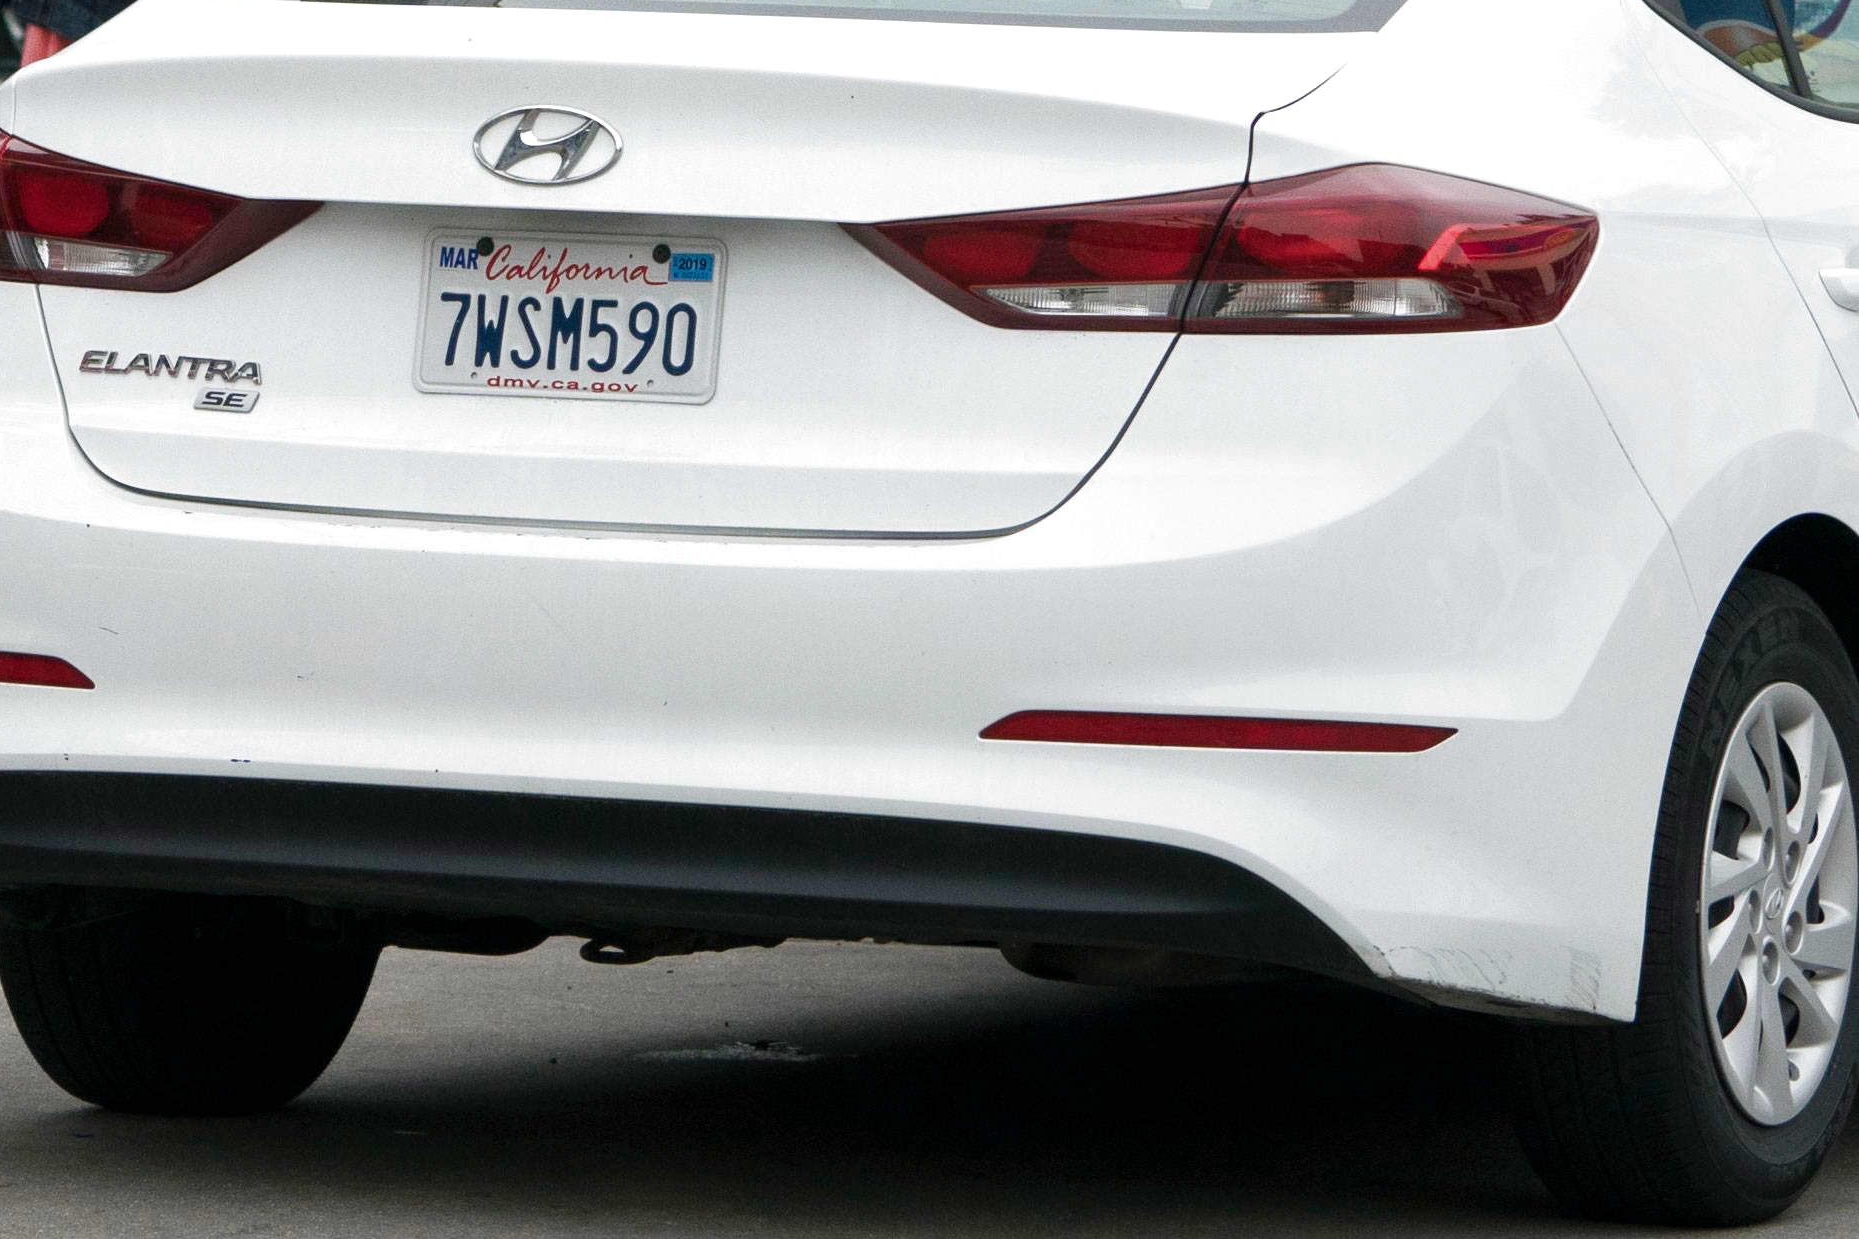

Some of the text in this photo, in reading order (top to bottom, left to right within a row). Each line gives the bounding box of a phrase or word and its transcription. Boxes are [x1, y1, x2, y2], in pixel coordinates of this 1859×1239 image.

[441, 244, 707, 294] MAR California 2019
[441, 292, 697, 376] 7WSM590
[79, 350, 262, 386] ELANTRA
[487, 376, 639, 394] dmv.ca.gov
[201, 391, 249, 408] SE
